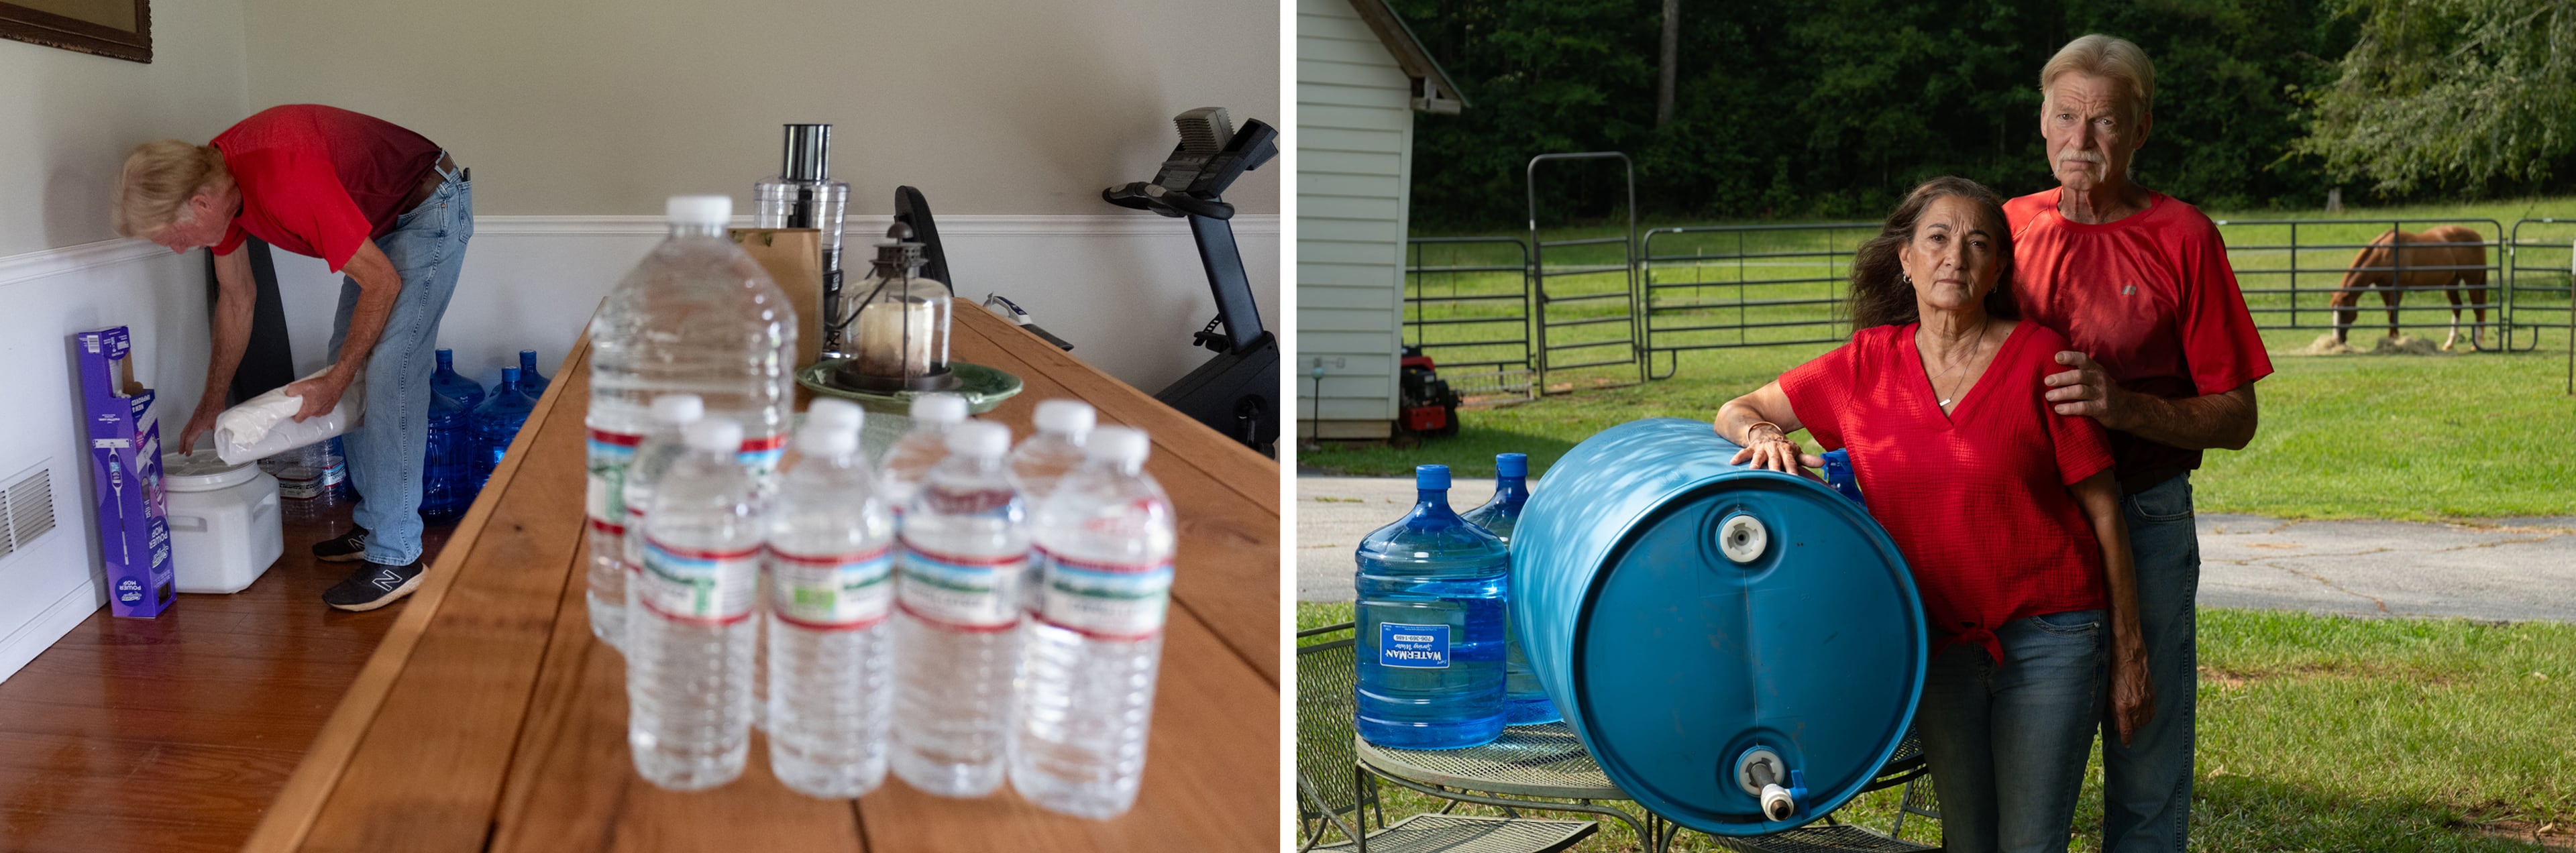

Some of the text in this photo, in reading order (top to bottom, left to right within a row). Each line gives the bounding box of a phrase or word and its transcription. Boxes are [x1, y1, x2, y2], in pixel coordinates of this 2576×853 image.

[152, 524, 163, 538] MOP
[149, 530, 168, 549] POWER
[372, 569, 403, 591] N
[1413, 642, 1432, 651] Spring
